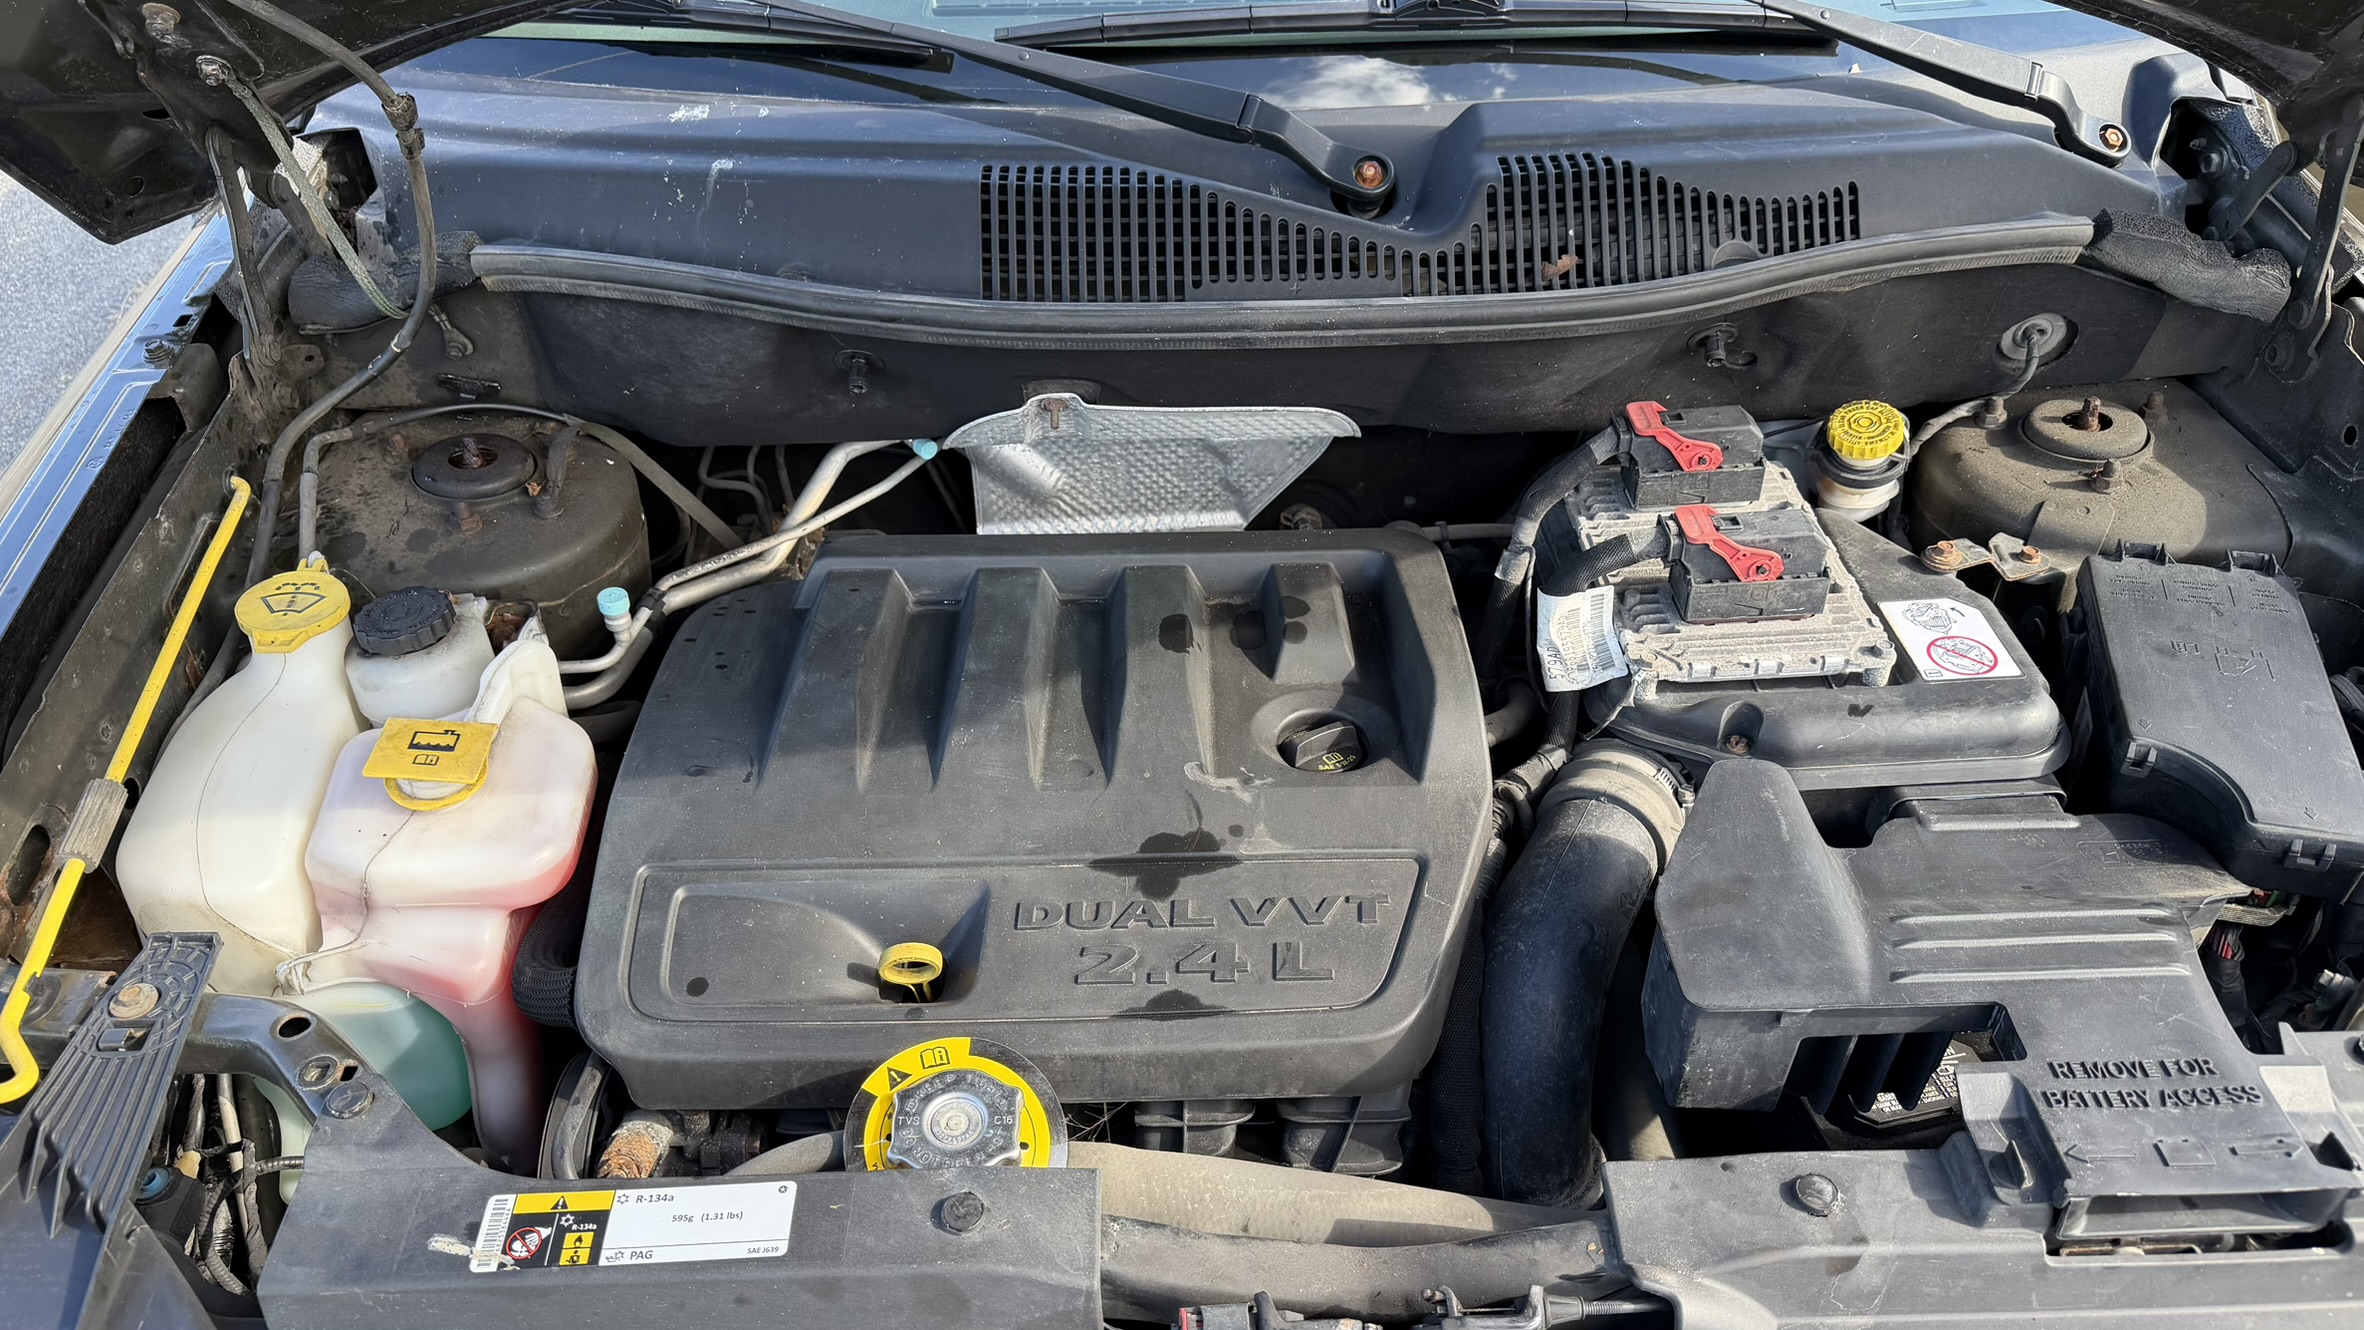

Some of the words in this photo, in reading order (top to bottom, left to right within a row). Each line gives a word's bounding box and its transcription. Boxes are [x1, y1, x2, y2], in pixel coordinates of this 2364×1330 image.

[1014, 899, 1216, 931] DUAL
[1229, 893, 1391, 927] VVT
[1074, 941, 1251, 985] 2.4
[1272, 940, 1335, 982] L
[2047, 1059, 2161, 1080] REMOVE
[2158, 1057, 2219, 1078] FOR
[2041, 1088, 2153, 1109] BATTERY
[2158, 1084, 2264, 1108] ACCESS
[897, 1116, 920, 1125] TVS
[994, 1115, 1013, 1125] C16
[900, 1128, 917, 1146] DO
[912, 1146, 939, 1166] NOT
[635, 1193, 674, 1204] R-134a
[672, 1214, 694, 1223] 595g
[700, 1213, 724, 1222] (1.31
[727, 1211, 744, 1220] lbs)
[571, 1223, 598, 1231] R-134a
[629, 1250, 654, 1260] PAG
[762, 1246, 779, 1254] J639
